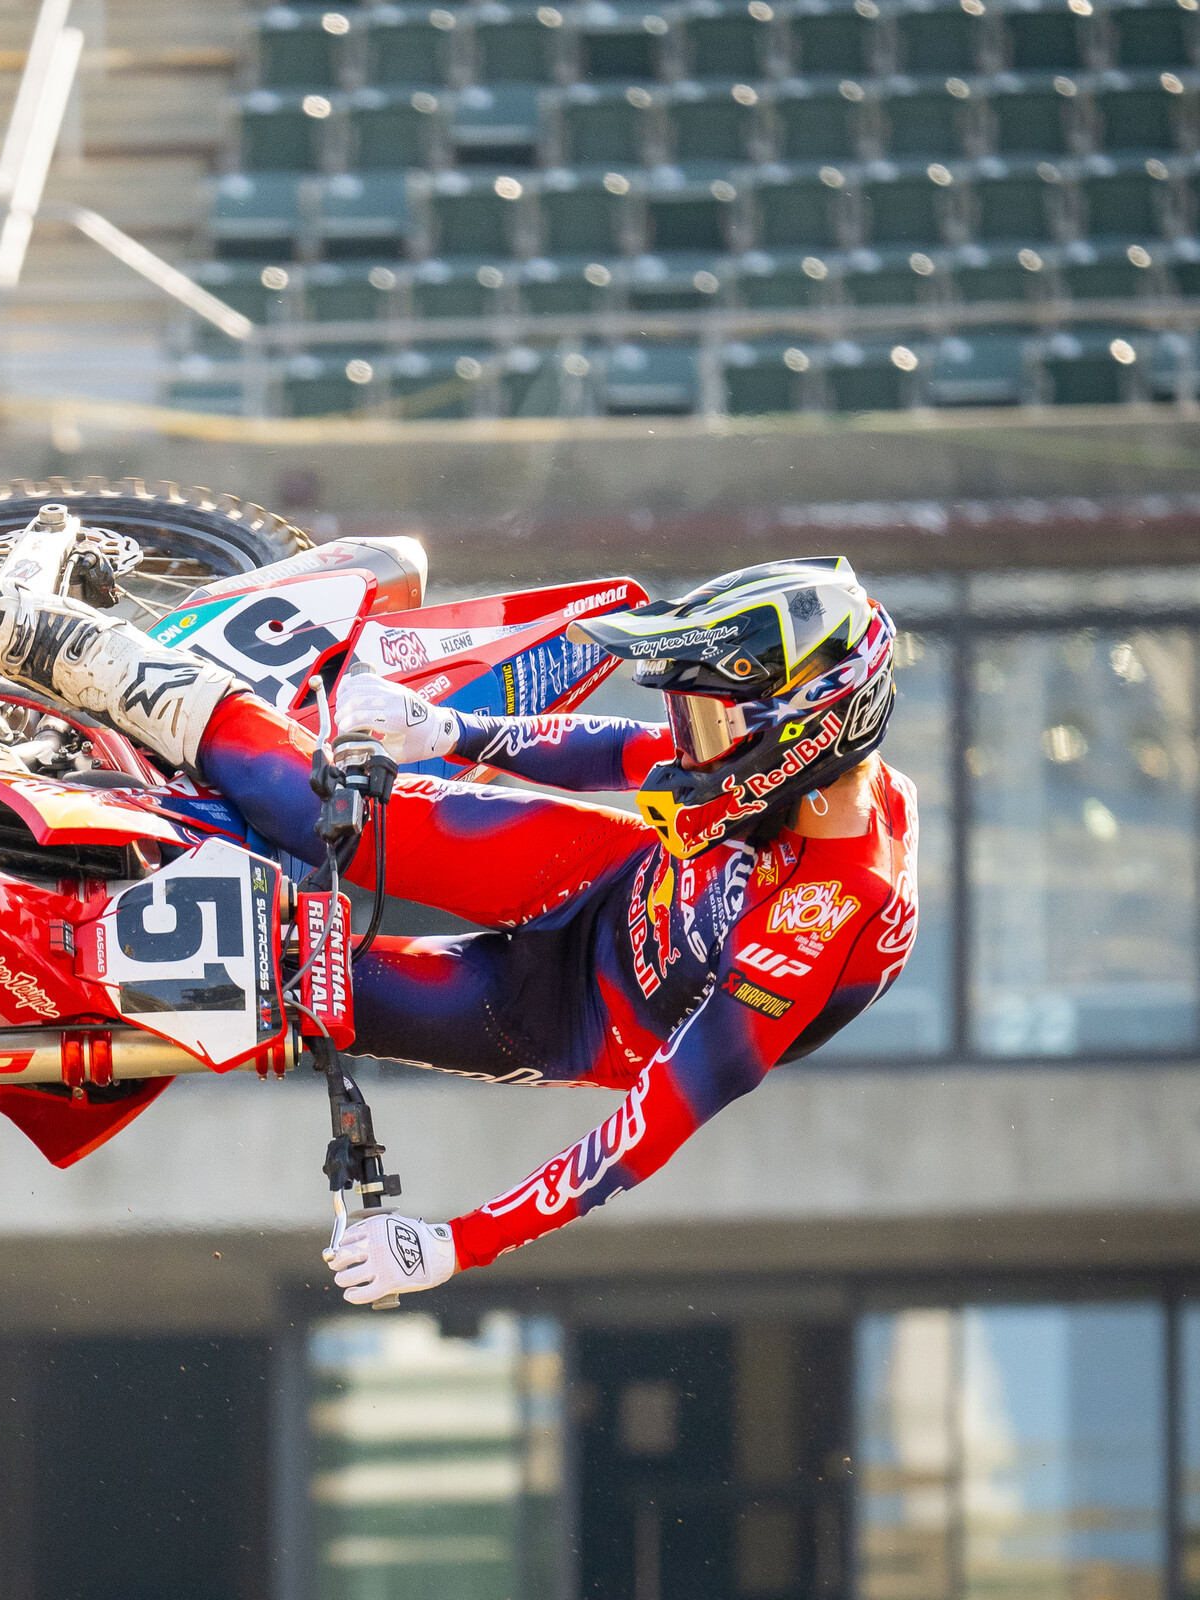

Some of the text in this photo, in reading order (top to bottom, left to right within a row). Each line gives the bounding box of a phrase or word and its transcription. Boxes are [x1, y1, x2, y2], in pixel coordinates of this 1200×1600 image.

[563, 585, 628, 618] DUNLOP
[441, 635, 473, 654] BN3TH
[630, 625, 738, 660] Troy Lee Designs
[419, 675, 450, 700] GASG
[746, 709, 844, 798] Red Bull
[783, 883, 836, 907] WOW
[769, 897, 856, 941] WOW!
[96, 927, 105, 973] GASGAS
[116, 876, 246, 1013] 51
[257, 898, 270, 991] SUPERCROSS
[308, 900, 328, 1017] RENTHAL
[329, 898, 347, 1017] RENTHAL
[629, 919, 662, 1000] Bull
[736, 942, 812, 978] WP
[4, 971, 60, 1018] Designs
